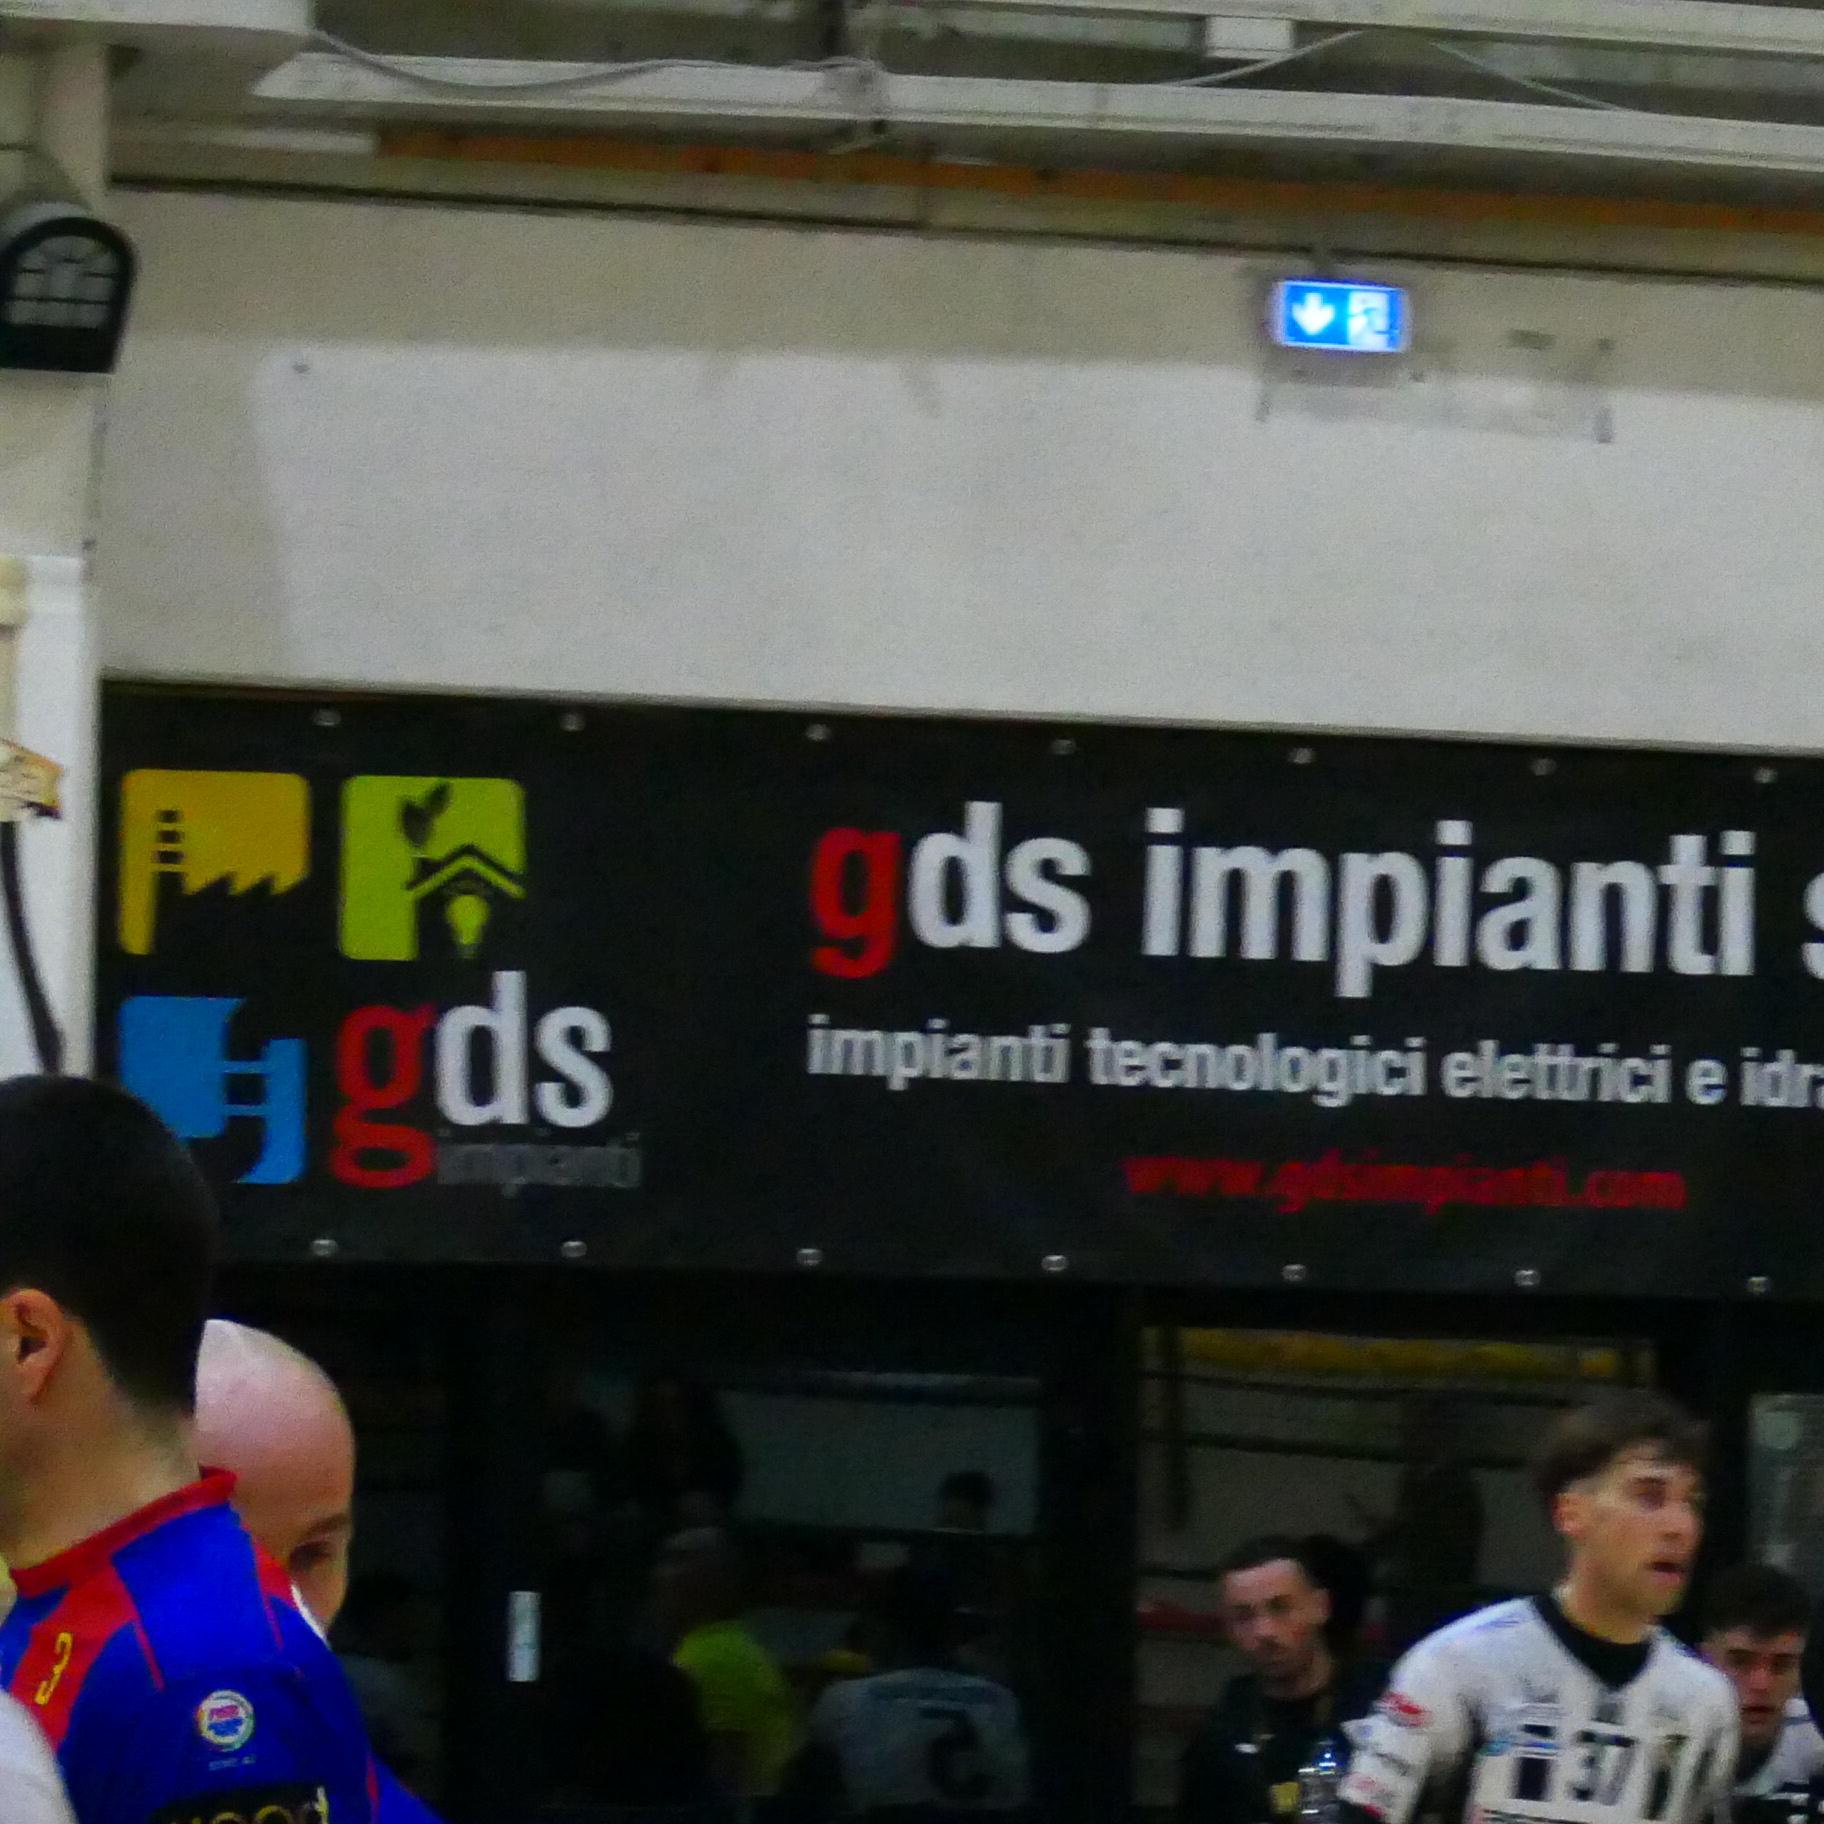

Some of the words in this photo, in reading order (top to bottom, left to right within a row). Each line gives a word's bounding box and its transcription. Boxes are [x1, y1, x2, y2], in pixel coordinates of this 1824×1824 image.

[807, 801, 1093, 979] gds
[1143, 805, 1757, 998] impianti
[330, 970, 613, 1189] gds
[808, 1013, 1071, 1091] impianti
[1084, 1027, 1427, 1108] tecnologici
[1440, 1038, 1672, 1104] elettrici
[1685, 1056, 1728, 1105] e
